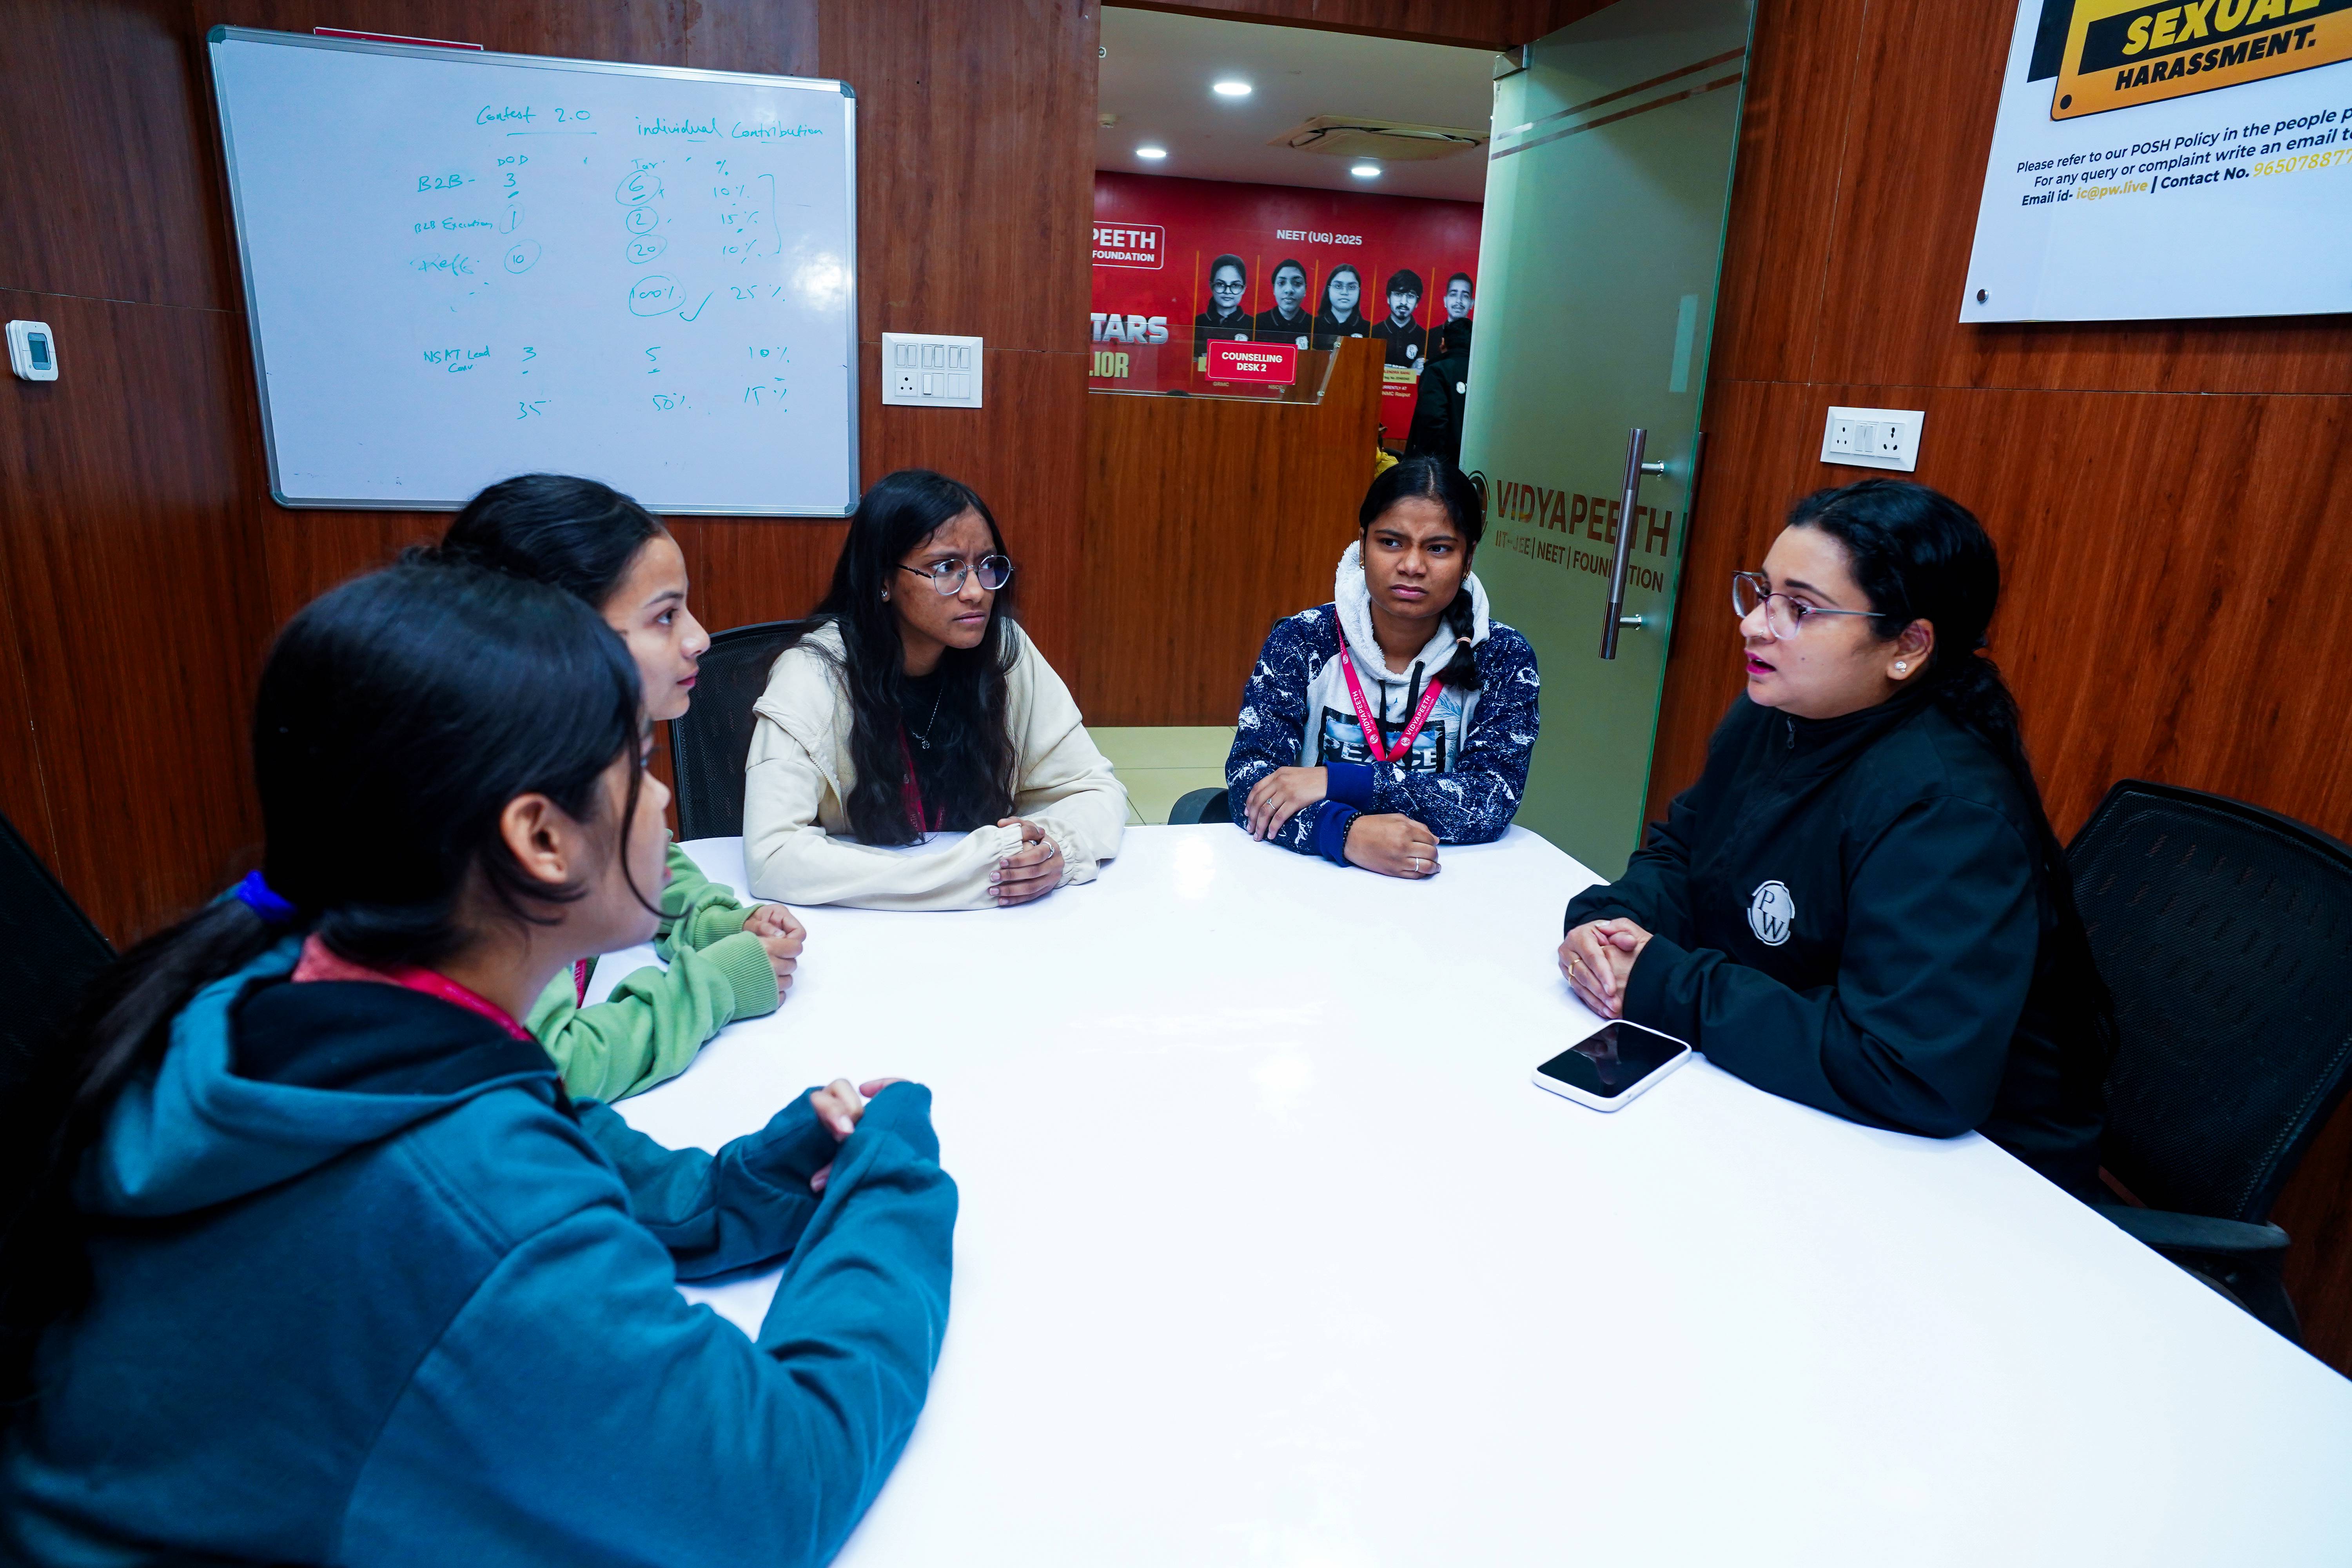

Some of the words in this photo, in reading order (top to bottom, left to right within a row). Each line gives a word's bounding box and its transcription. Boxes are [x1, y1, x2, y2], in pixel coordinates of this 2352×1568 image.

[2115, 24, 2316, 91] HARASSMENT.
[477, 105, 537, 125] Contest
[555, 108, 590, 122] 2.0
[2017, 161, 2054, 173] Please
[2057, 154, 2086, 167] refer
[2089, 152, 2102, 162] to
[2105, 147, 2128, 160] our
[2131, 139, 2171, 156] POSH
[2174, 132, 2220, 149] Policy
[2223, 127, 2238, 142] in
[2243, 123, 2270, 138] the
[2273, 109, 2337, 136] people
[2034, 176, 2053, 187] For
[2056, 173, 2078, 185] any
[2081, 167, 2118, 183] query
[2121, 164, 2135, 175] or
[2138, 152, 2211, 173] complaint
[2216, 145, 2256, 162] write
[2260, 142, 2281, 155] an
[2287, 128, 2338, 150] email
[2022, 191, 2054, 206] Email
[2057, 189, 2073, 202] id-
[2076, 180, 2149, 201] ic@pw.live
[2161, 170, 2220, 189] Contact
[2224, 167, 2250, 181] No.
[1092, 250, 1154, 262] FOUNDATION
[1276, 229, 1307, 241] NEET
[1308, 230, 1333, 245] (UG)
[1334, 234, 1362, 245] 2025
[1089, 351, 1129, 378] IOR
[1221, 351, 1283, 363] COUNSELLING
[1236, 362, 1260, 372] DESK
[1260, 363, 1267, 372] 2
[1537, 541, 1566, 564] NEET
[1572, 550, 1664, 593] FOUNTION
[1352, 691, 1372, 734] VIDYAPEETH
[1405, 695, 1431, 735] VIDYAPEETH
